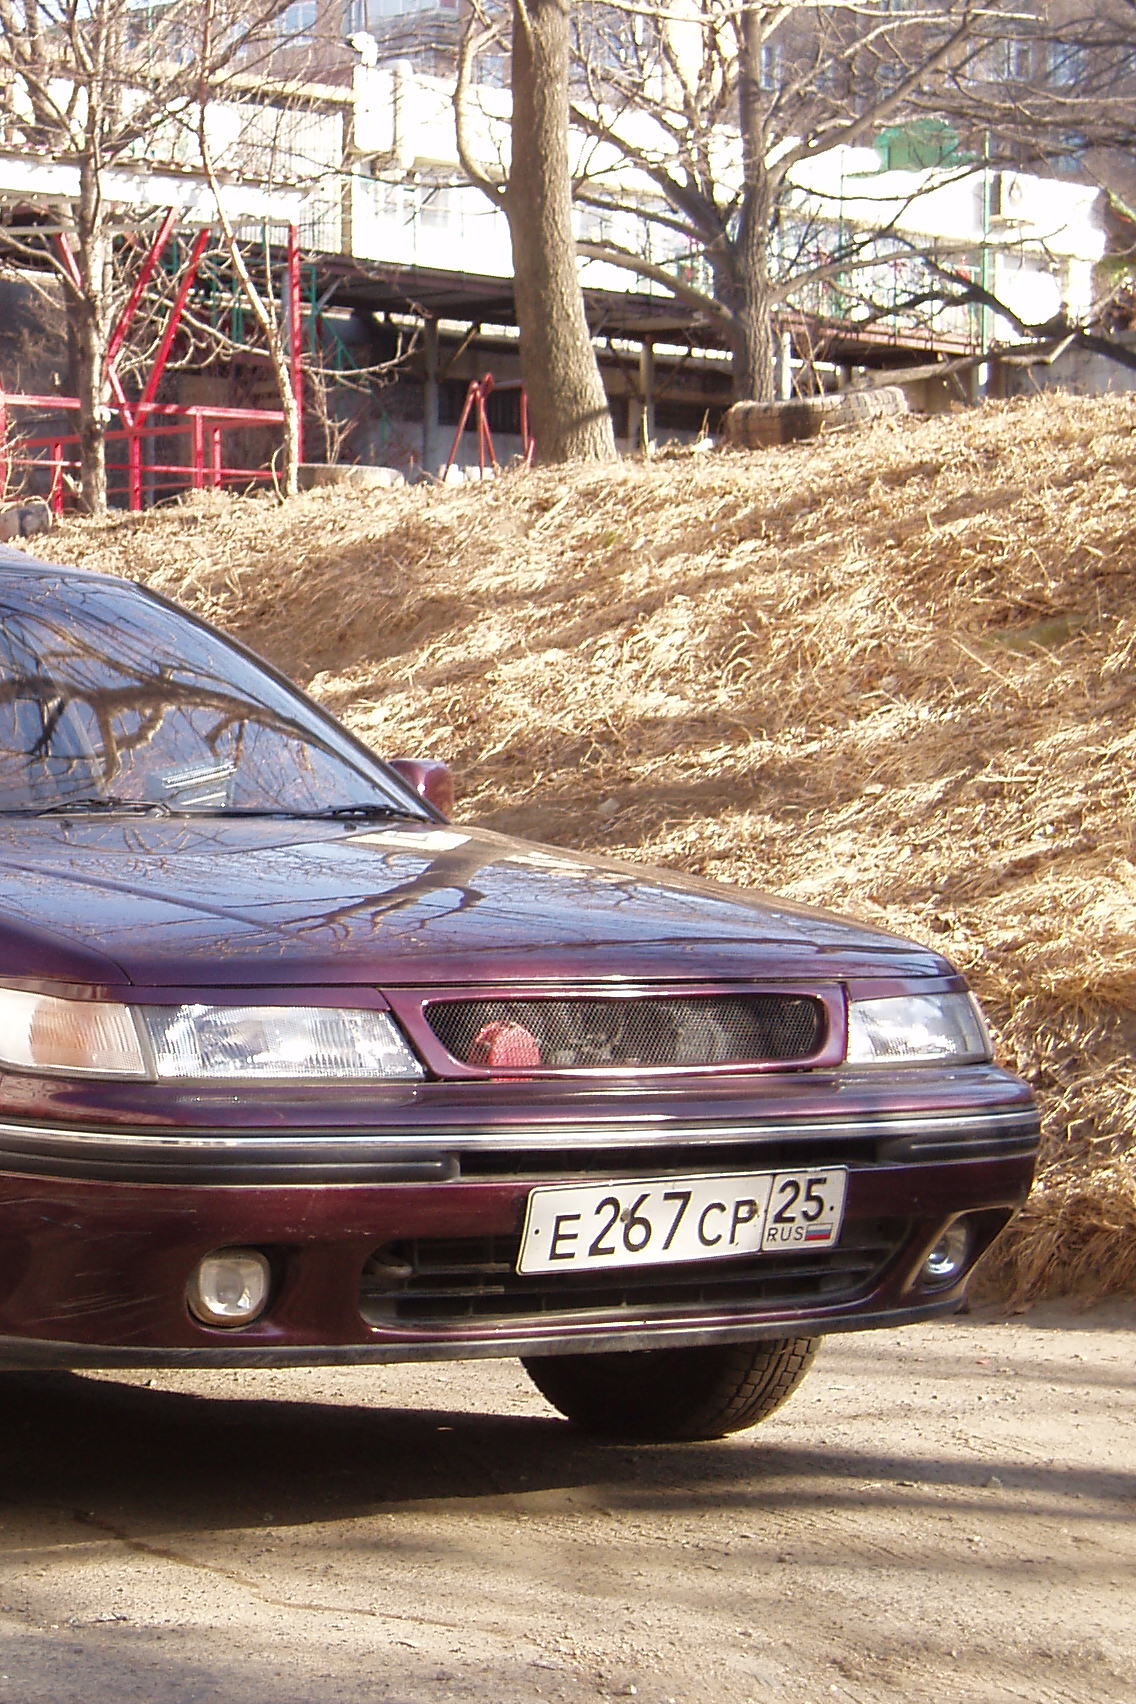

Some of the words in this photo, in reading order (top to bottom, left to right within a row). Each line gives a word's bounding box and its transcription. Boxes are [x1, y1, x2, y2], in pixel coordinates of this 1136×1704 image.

[548, 1190, 758, 1261] E267CP
[772, 1176, 827, 1224] 25
[766, 1226, 804, 1243] RUS
